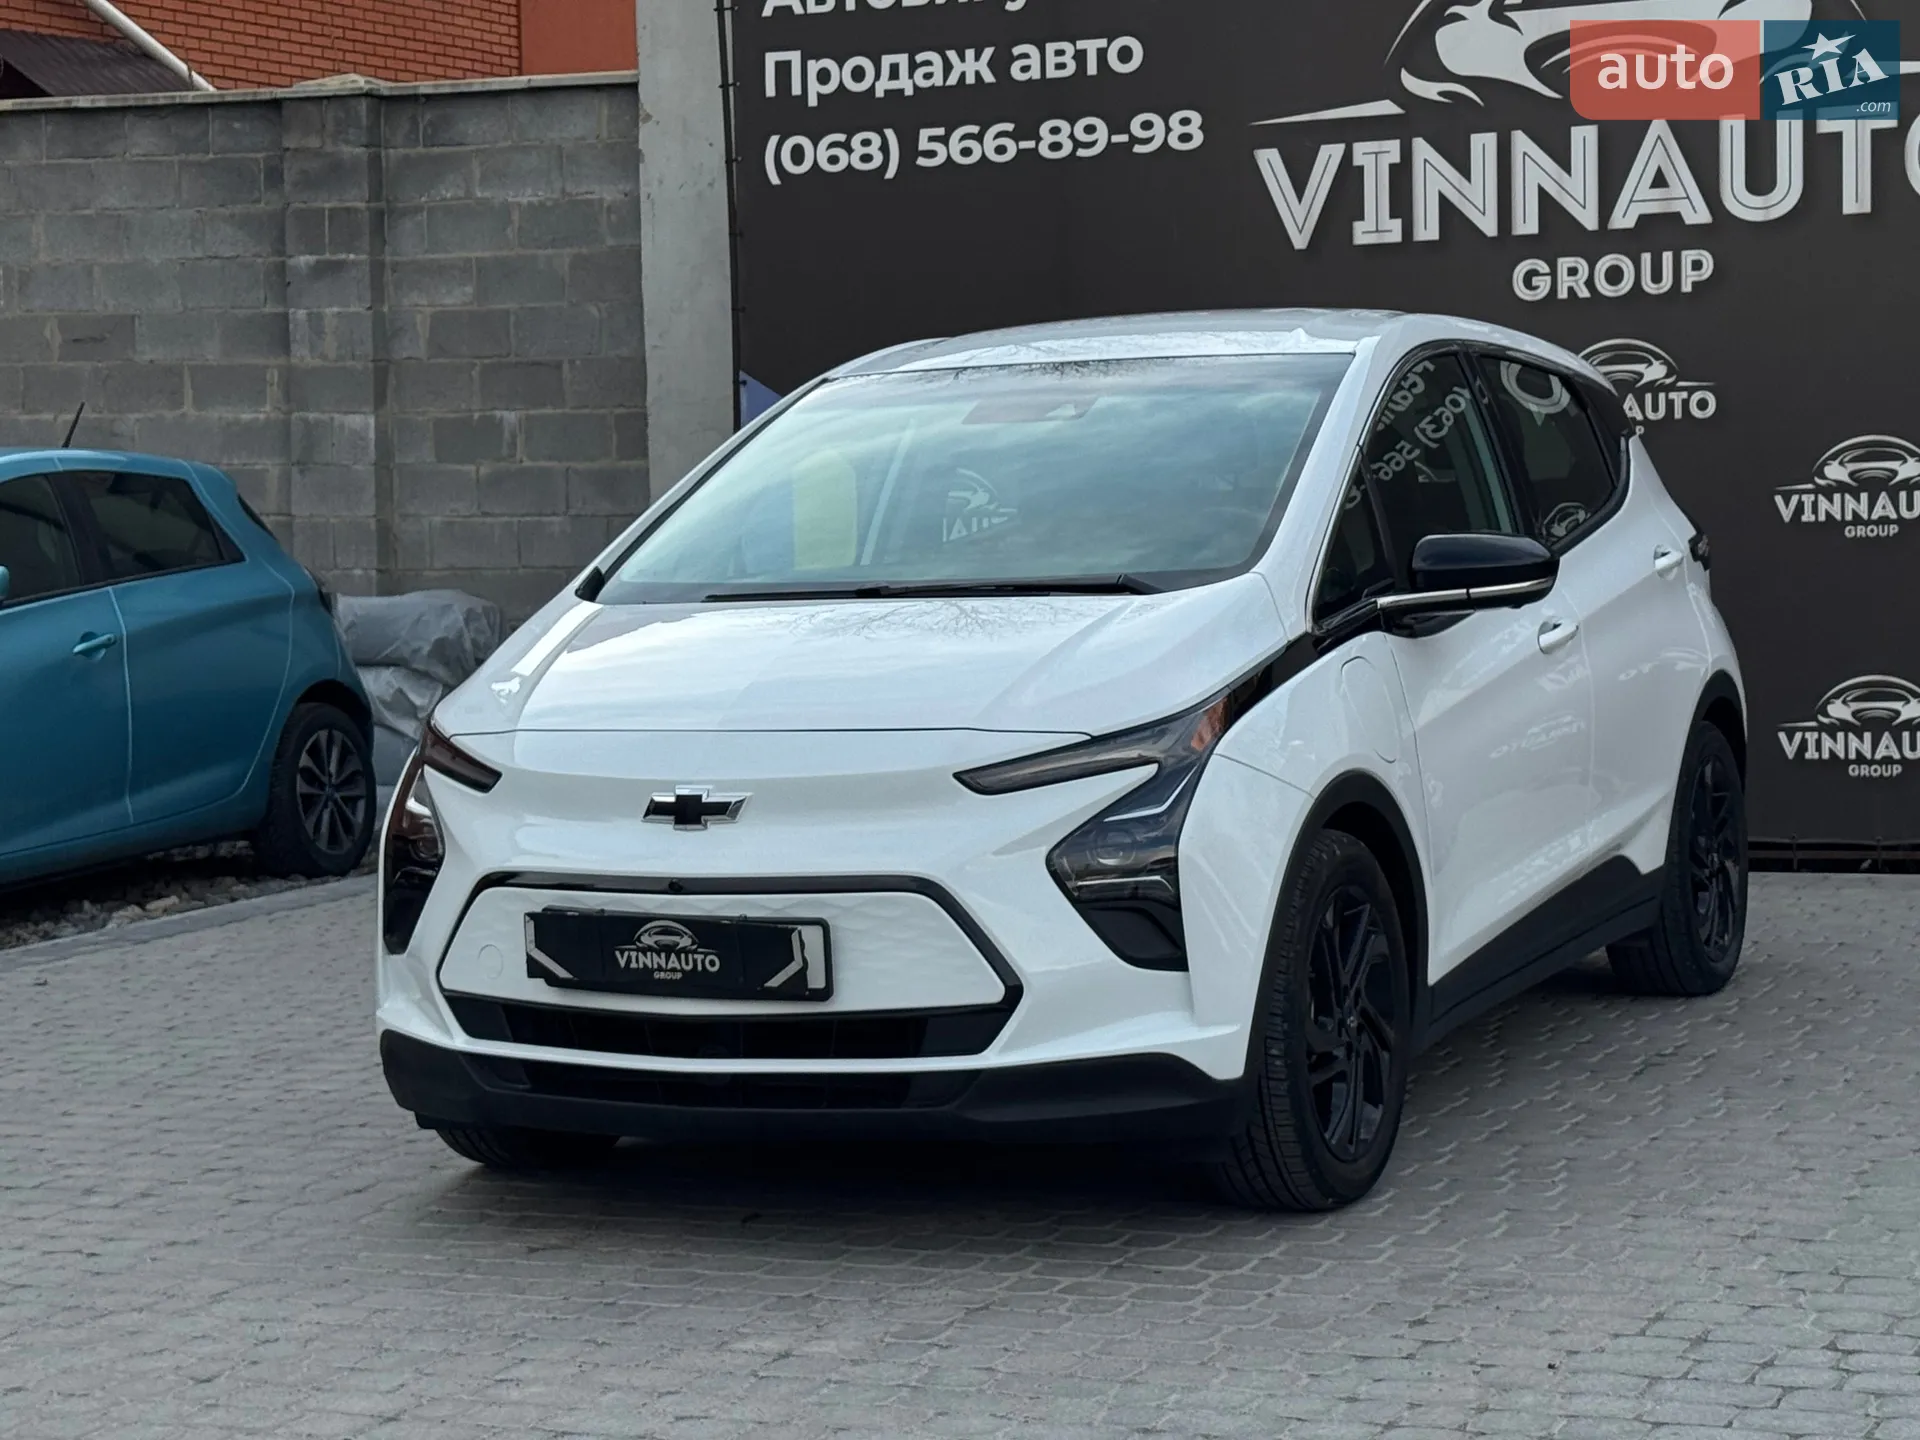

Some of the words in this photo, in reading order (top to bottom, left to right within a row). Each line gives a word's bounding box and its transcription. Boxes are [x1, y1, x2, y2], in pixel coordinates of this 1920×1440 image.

[763, 46, 996, 107] Продаж
[1009, 35, 1144, 81] авто
[764, 128, 901, 186] (068)
[915, 109, 1204, 168] 566-89-98
[1253, 101, 1920, 251] VINNAUT
[1511, 249, 1715, 302] GROUP
[1623, 390, 1717, 421] AUTO
[1773, 490, 1920, 523] VINNAU
[1844, 524, 1899, 538] GROUP
[1777, 731, 1920, 760] VINNAU
[1848, 764, 1903, 777] GROUP
[614, 950, 720, 972] VINNAUTO
[653, 971, 683, 980] GROUP
